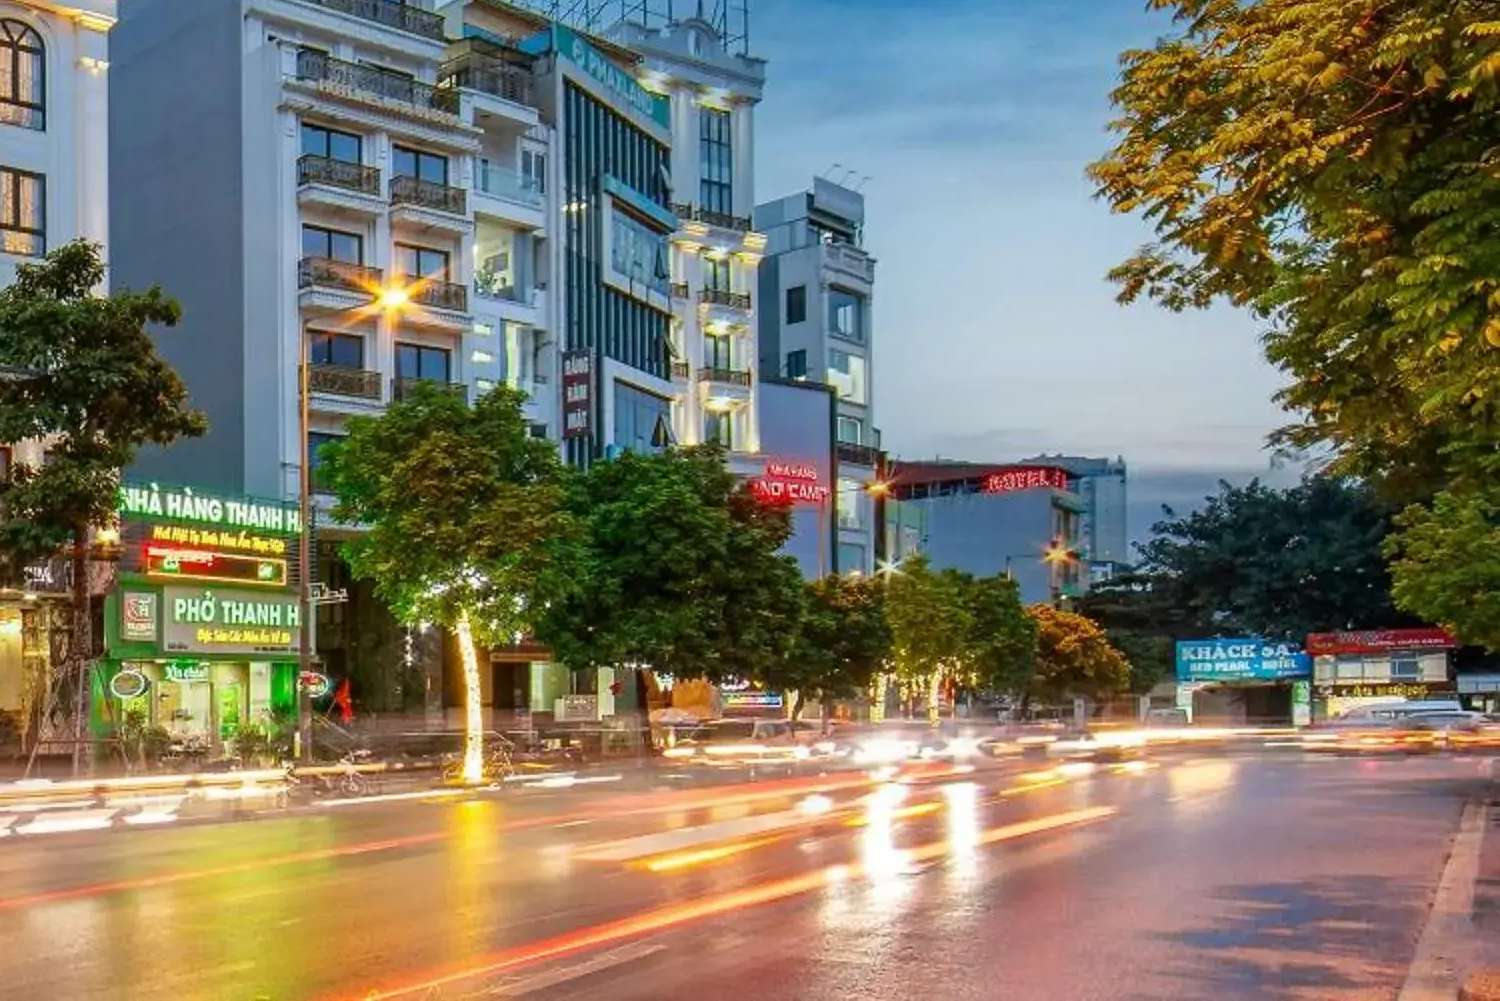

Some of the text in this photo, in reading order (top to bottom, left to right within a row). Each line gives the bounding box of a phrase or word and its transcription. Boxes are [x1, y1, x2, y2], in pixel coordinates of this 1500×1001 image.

[120, 483, 303, 533] NHÀ HÀNG THANH H
[174, 590, 216, 622] PHỞ
[221, 600, 282, 626] THANH
[287, 605, 302, 627] H
[1214, 660, 1251, 672] PEARL
